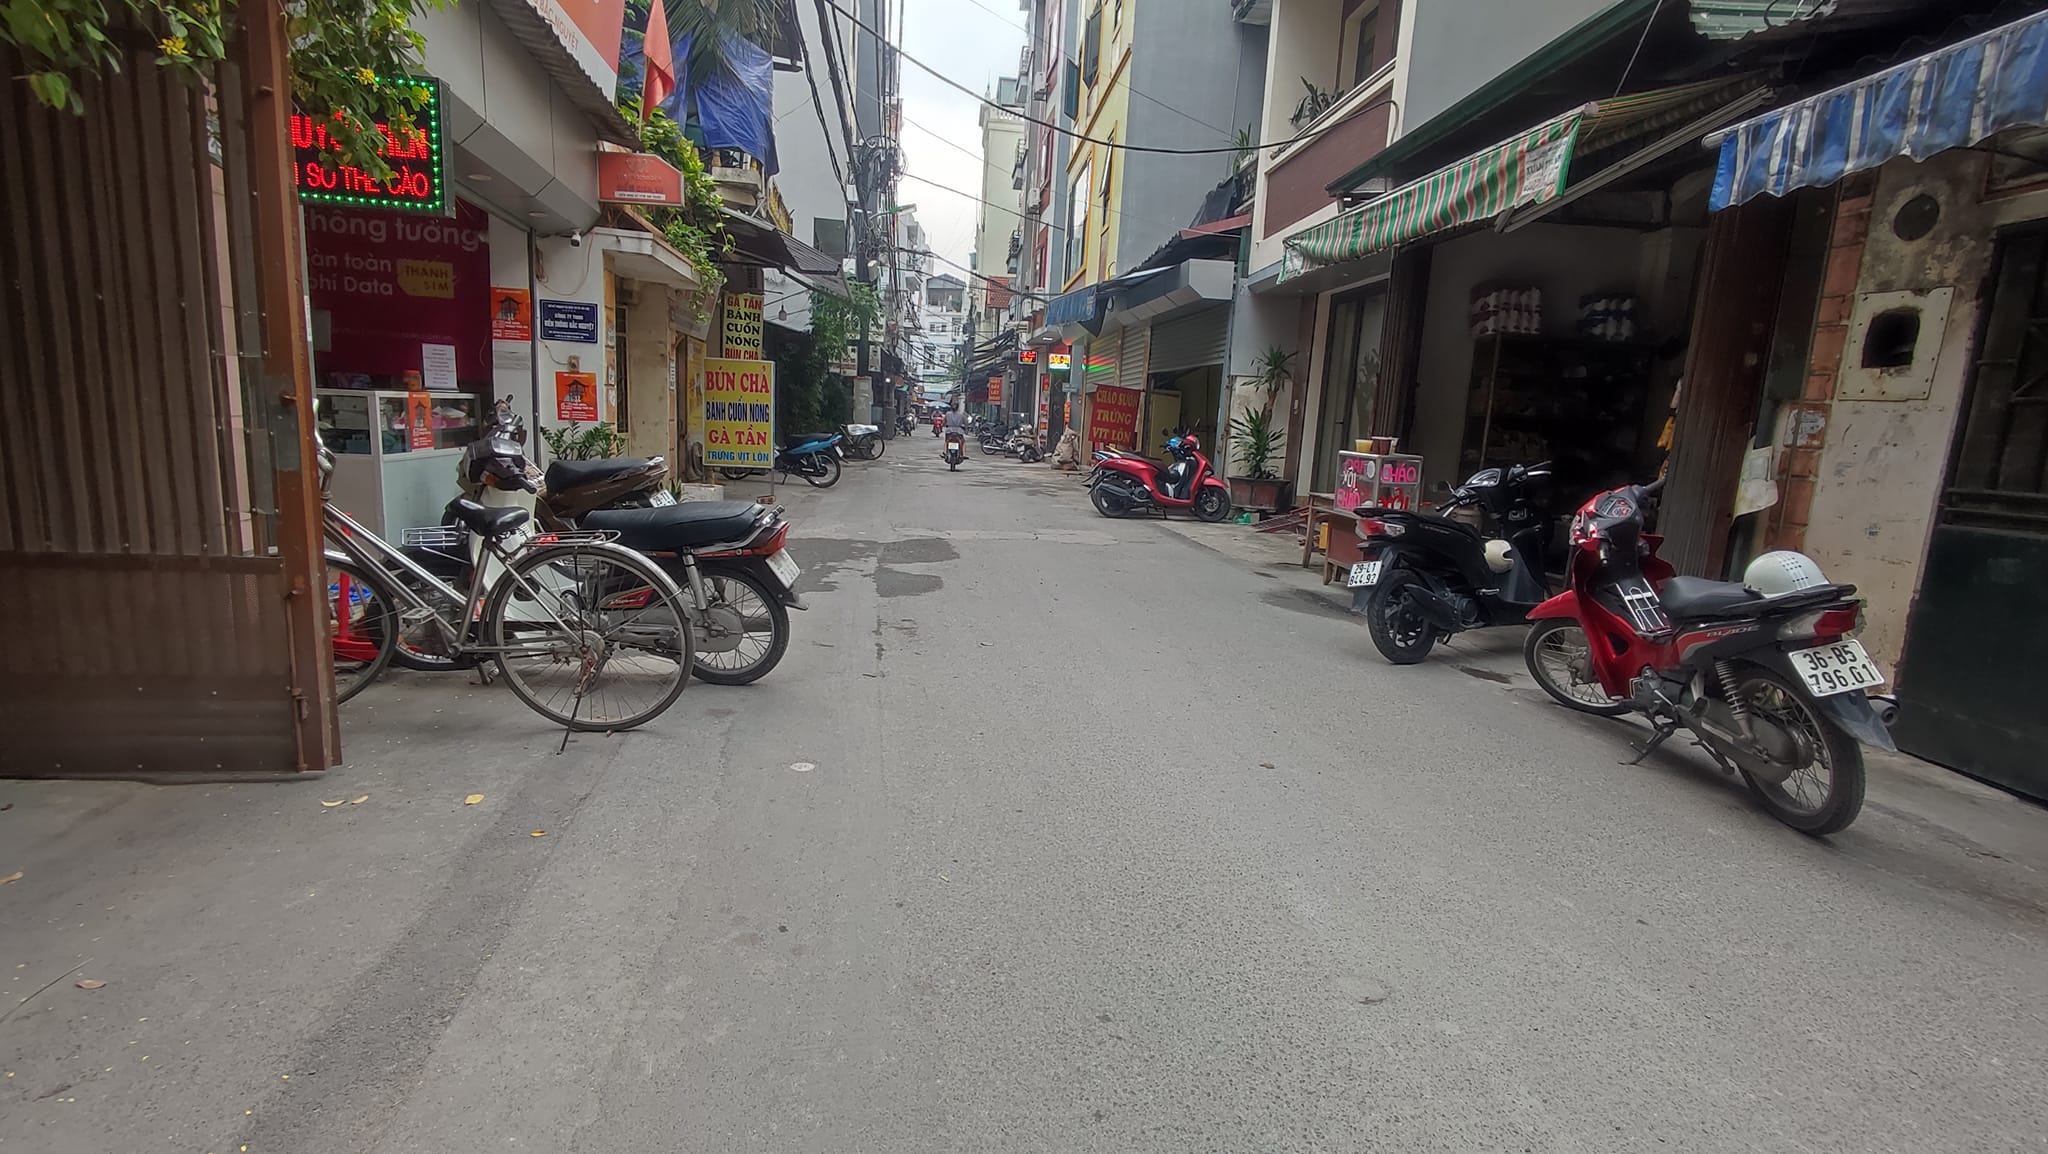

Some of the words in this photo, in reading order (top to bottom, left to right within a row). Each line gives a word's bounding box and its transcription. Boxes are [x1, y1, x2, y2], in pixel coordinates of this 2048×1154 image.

[344, 252, 392, 273] toàn
[344, 276, 393, 296] Data
[726, 307, 761, 323] BÁNH
[726, 320, 761, 335] CUỐN
[725, 333, 760, 348] NÓNG
[704, 366, 736, 392] BÚN
[740, 365, 770, 394] CHẢ
[1096, 388, 1117, 404] CHÁO
[706, 396, 726, 421] BÁNH
[727, 395, 748, 423] CUỐN
[749, 399, 770, 423] NÓNG
[1096, 408, 1132, 426] TRỨNG
[708, 426, 731, 444] GÀ
[735, 424, 768, 446] TẦN
[1382, 462, 1417, 483] CHÁO
[1803, 645, 1857, 671] 36-B5
